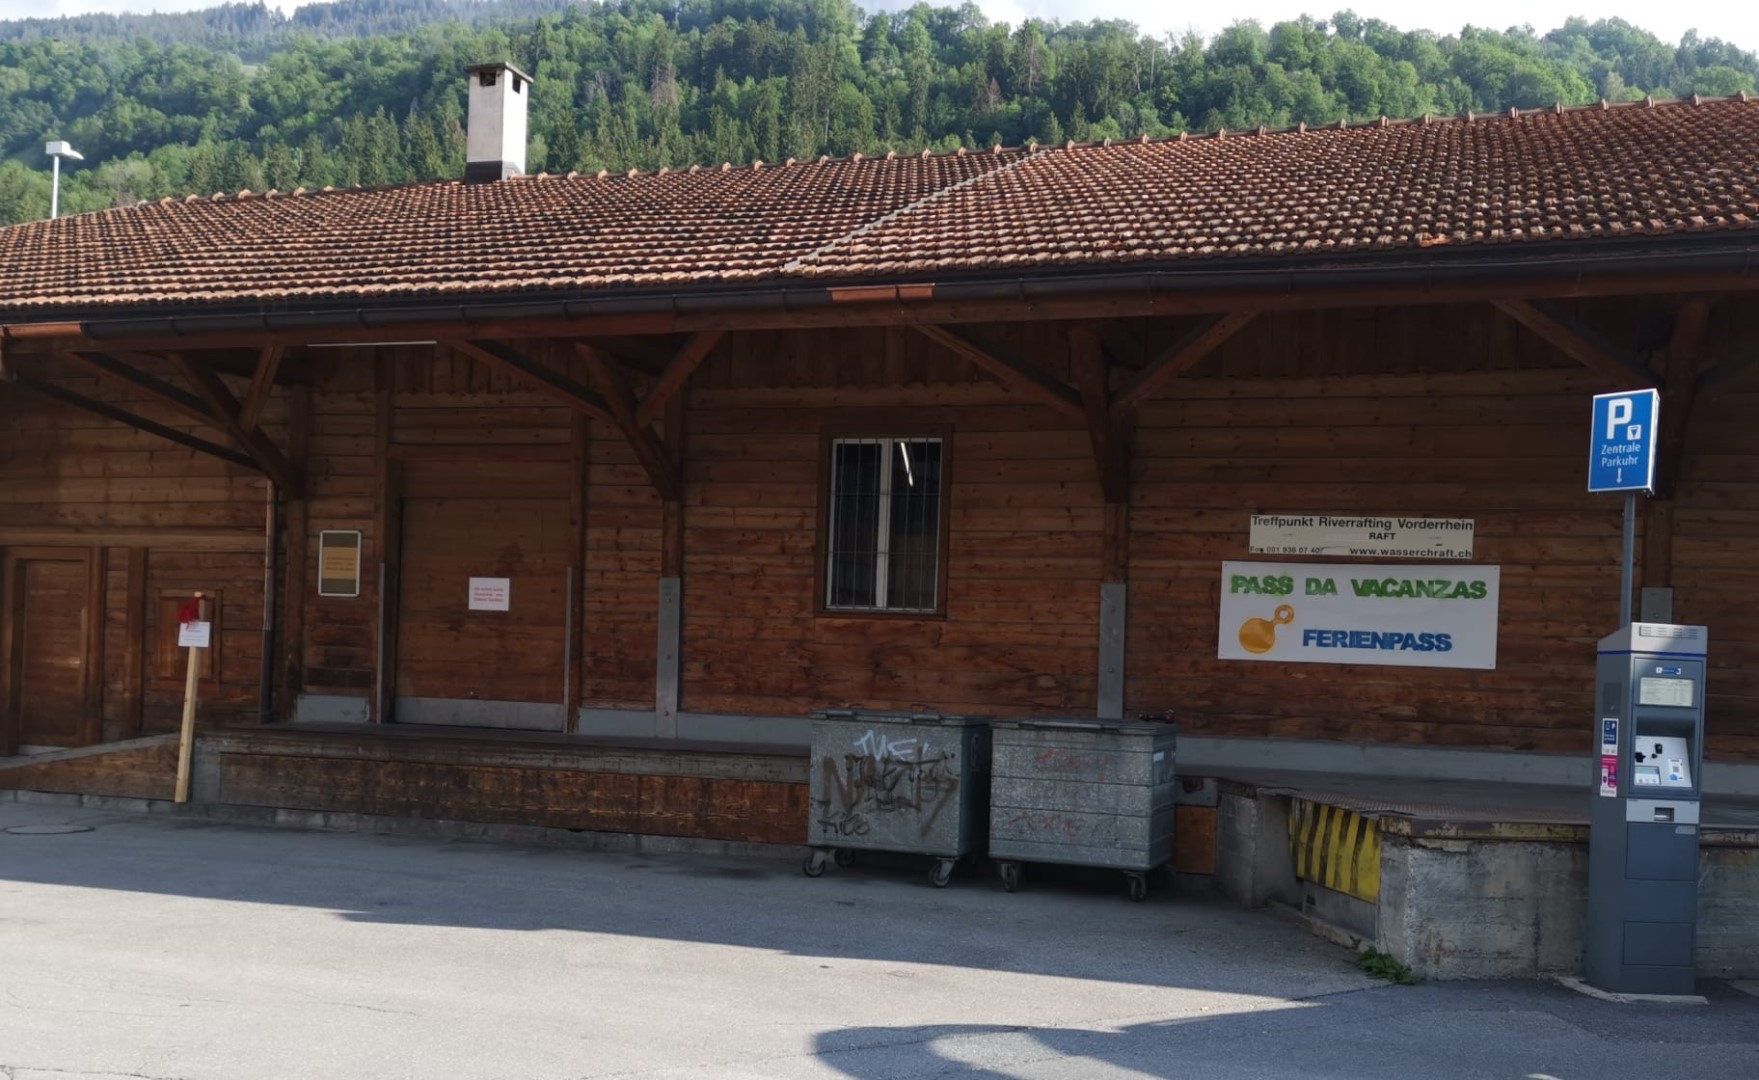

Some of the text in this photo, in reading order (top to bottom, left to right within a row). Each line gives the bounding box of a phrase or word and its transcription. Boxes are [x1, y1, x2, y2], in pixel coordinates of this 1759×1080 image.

[1606, 398, 1633, 440] P
[1601, 442, 1641, 455] Zentrale
[1601, 455, 1639, 467] Parkuhr
[1252, 516, 1473, 531] Treffpunkt Riverrafting Vorderrhein
[1369, 532, 1396, 540] RAFT
[1350, 547, 1472, 558] www.wasserchraft.ch
[1230, 575, 1488, 600] PASS DA VACANZAS
[1302, 629, 1453, 652] FERIENPASS
